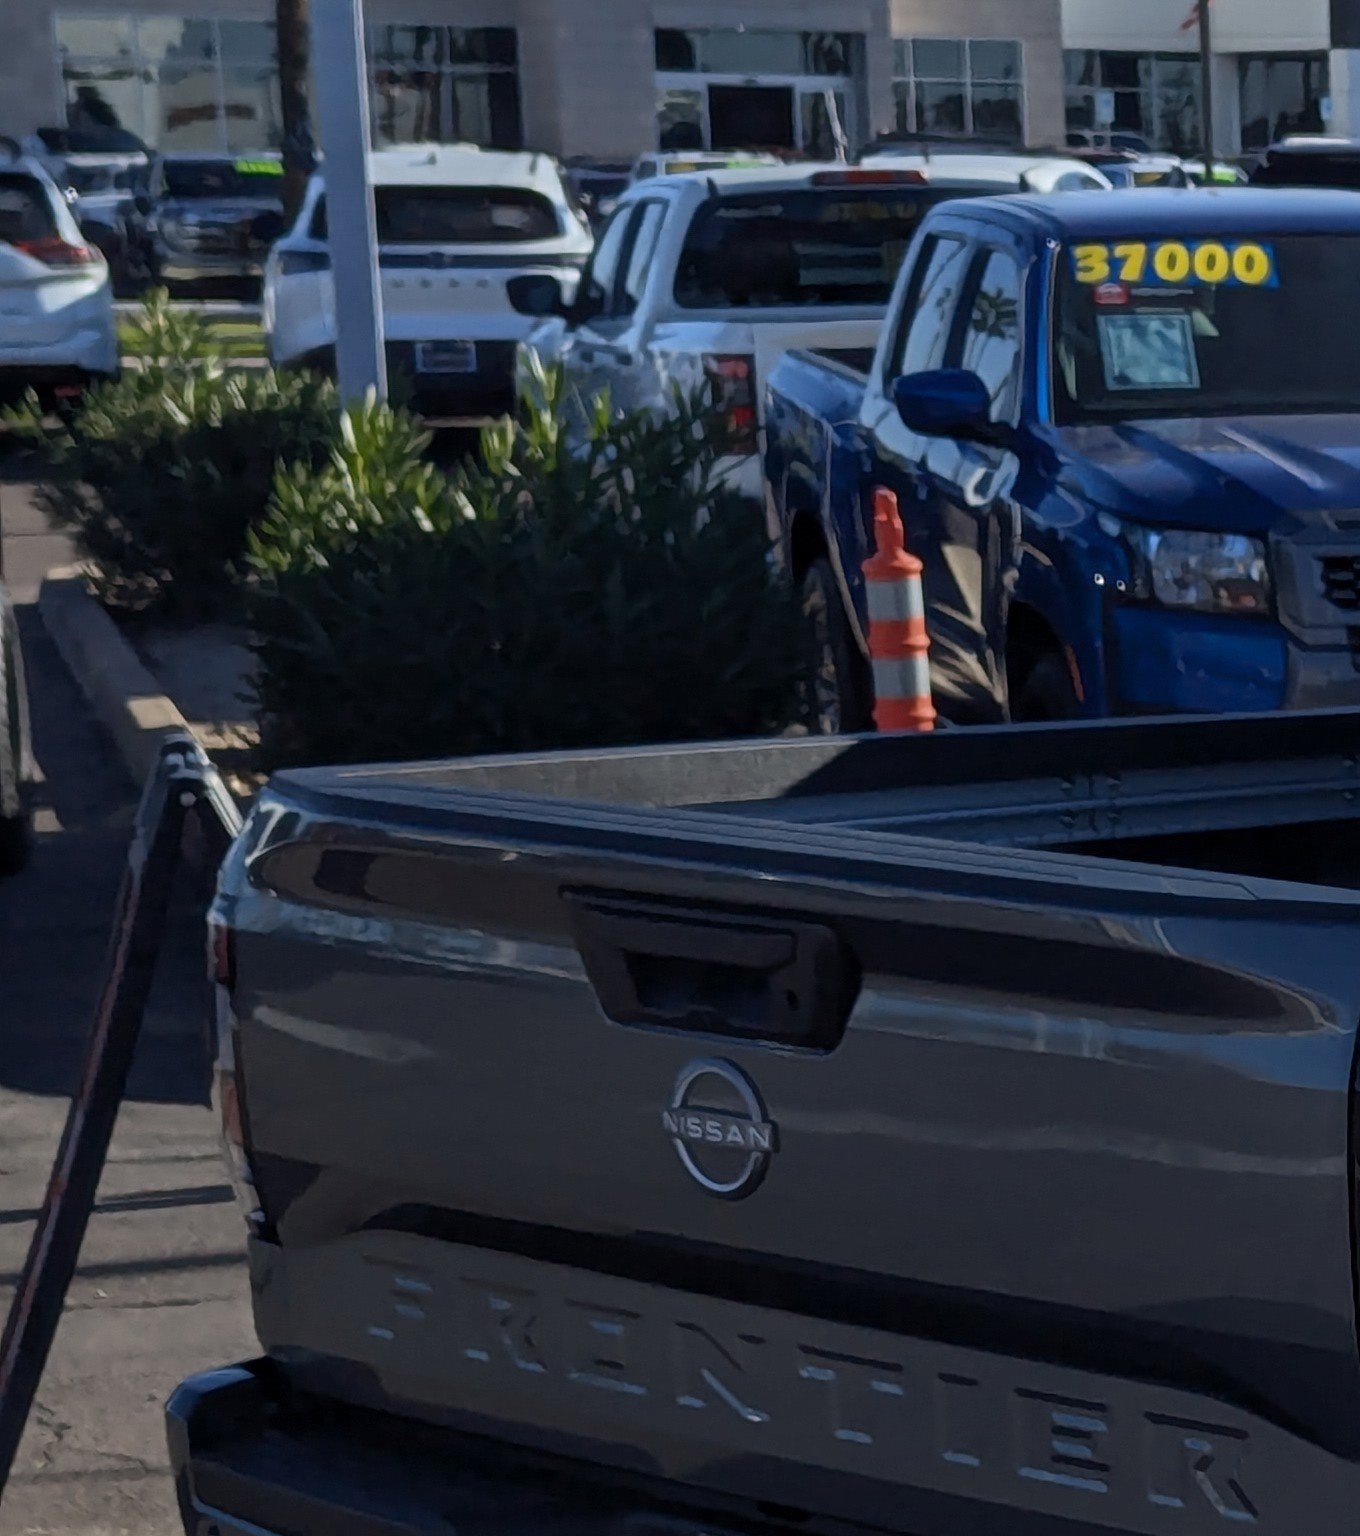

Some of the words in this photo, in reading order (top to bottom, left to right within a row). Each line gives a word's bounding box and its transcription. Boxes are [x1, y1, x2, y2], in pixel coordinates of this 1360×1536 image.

[1073, 243, 1269, 285] 37000
[662, 1110, 771, 1149] NISSAN
[361, 1254, 1261, 1524] FRONTIER
